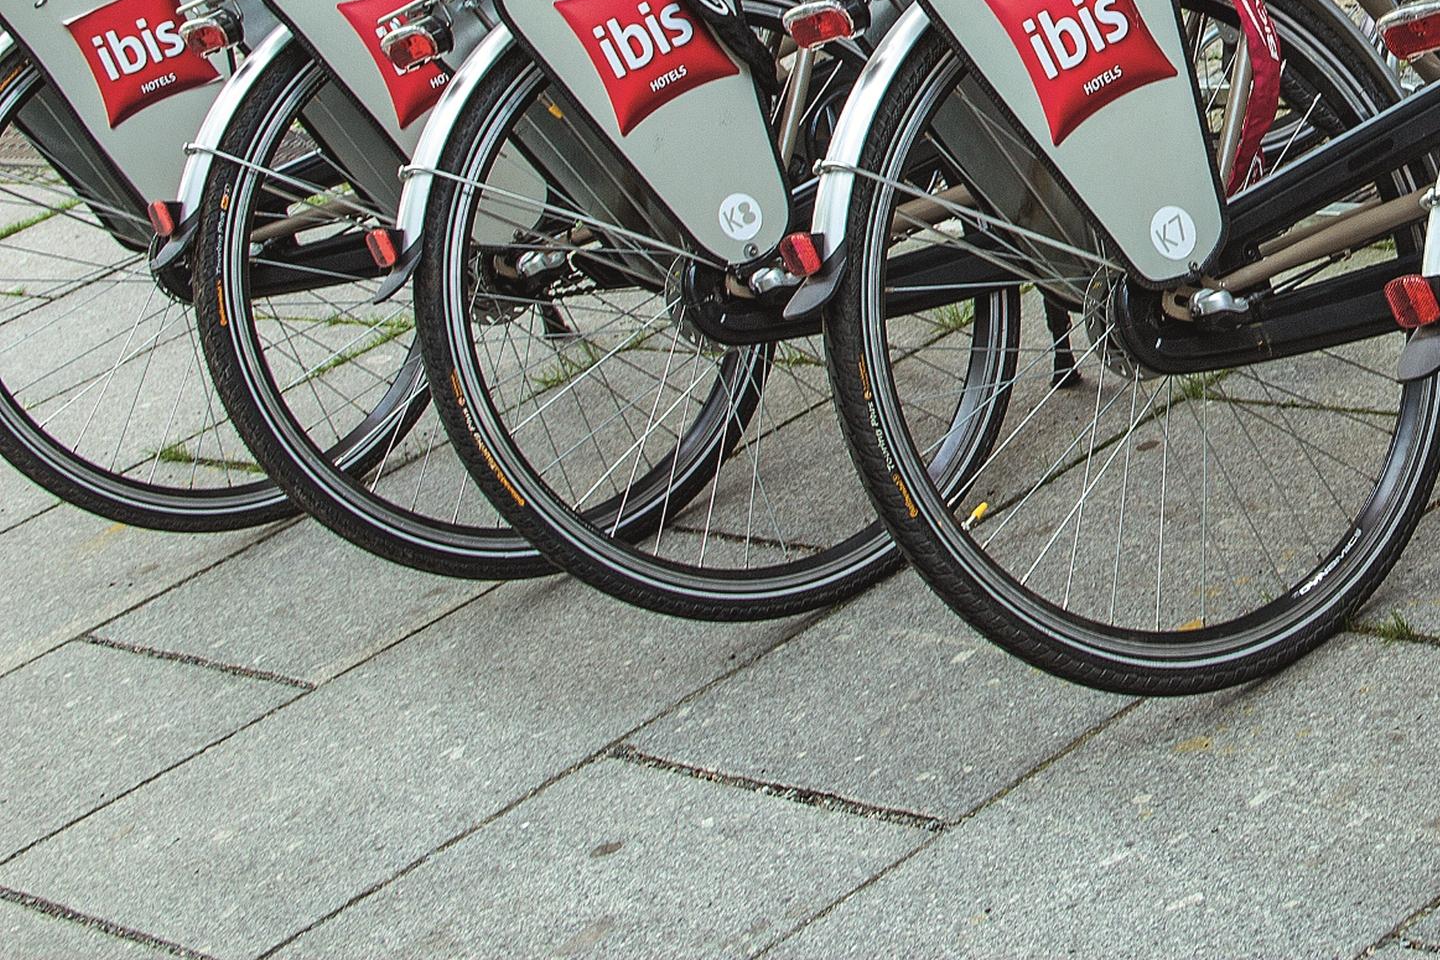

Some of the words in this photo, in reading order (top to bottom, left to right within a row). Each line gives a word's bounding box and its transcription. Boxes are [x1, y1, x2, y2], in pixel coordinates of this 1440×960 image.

[91, 17, 185, 82] ibis
[592, 1, 694, 80] ibis
[141, 72, 177, 94] HOTELS
[650, 64, 688, 92] HOTELS
[1083, 64, 1123, 96] HOTELS
[723, 201, 756, 232] K8
[1155, 213, 1185, 253] K7
